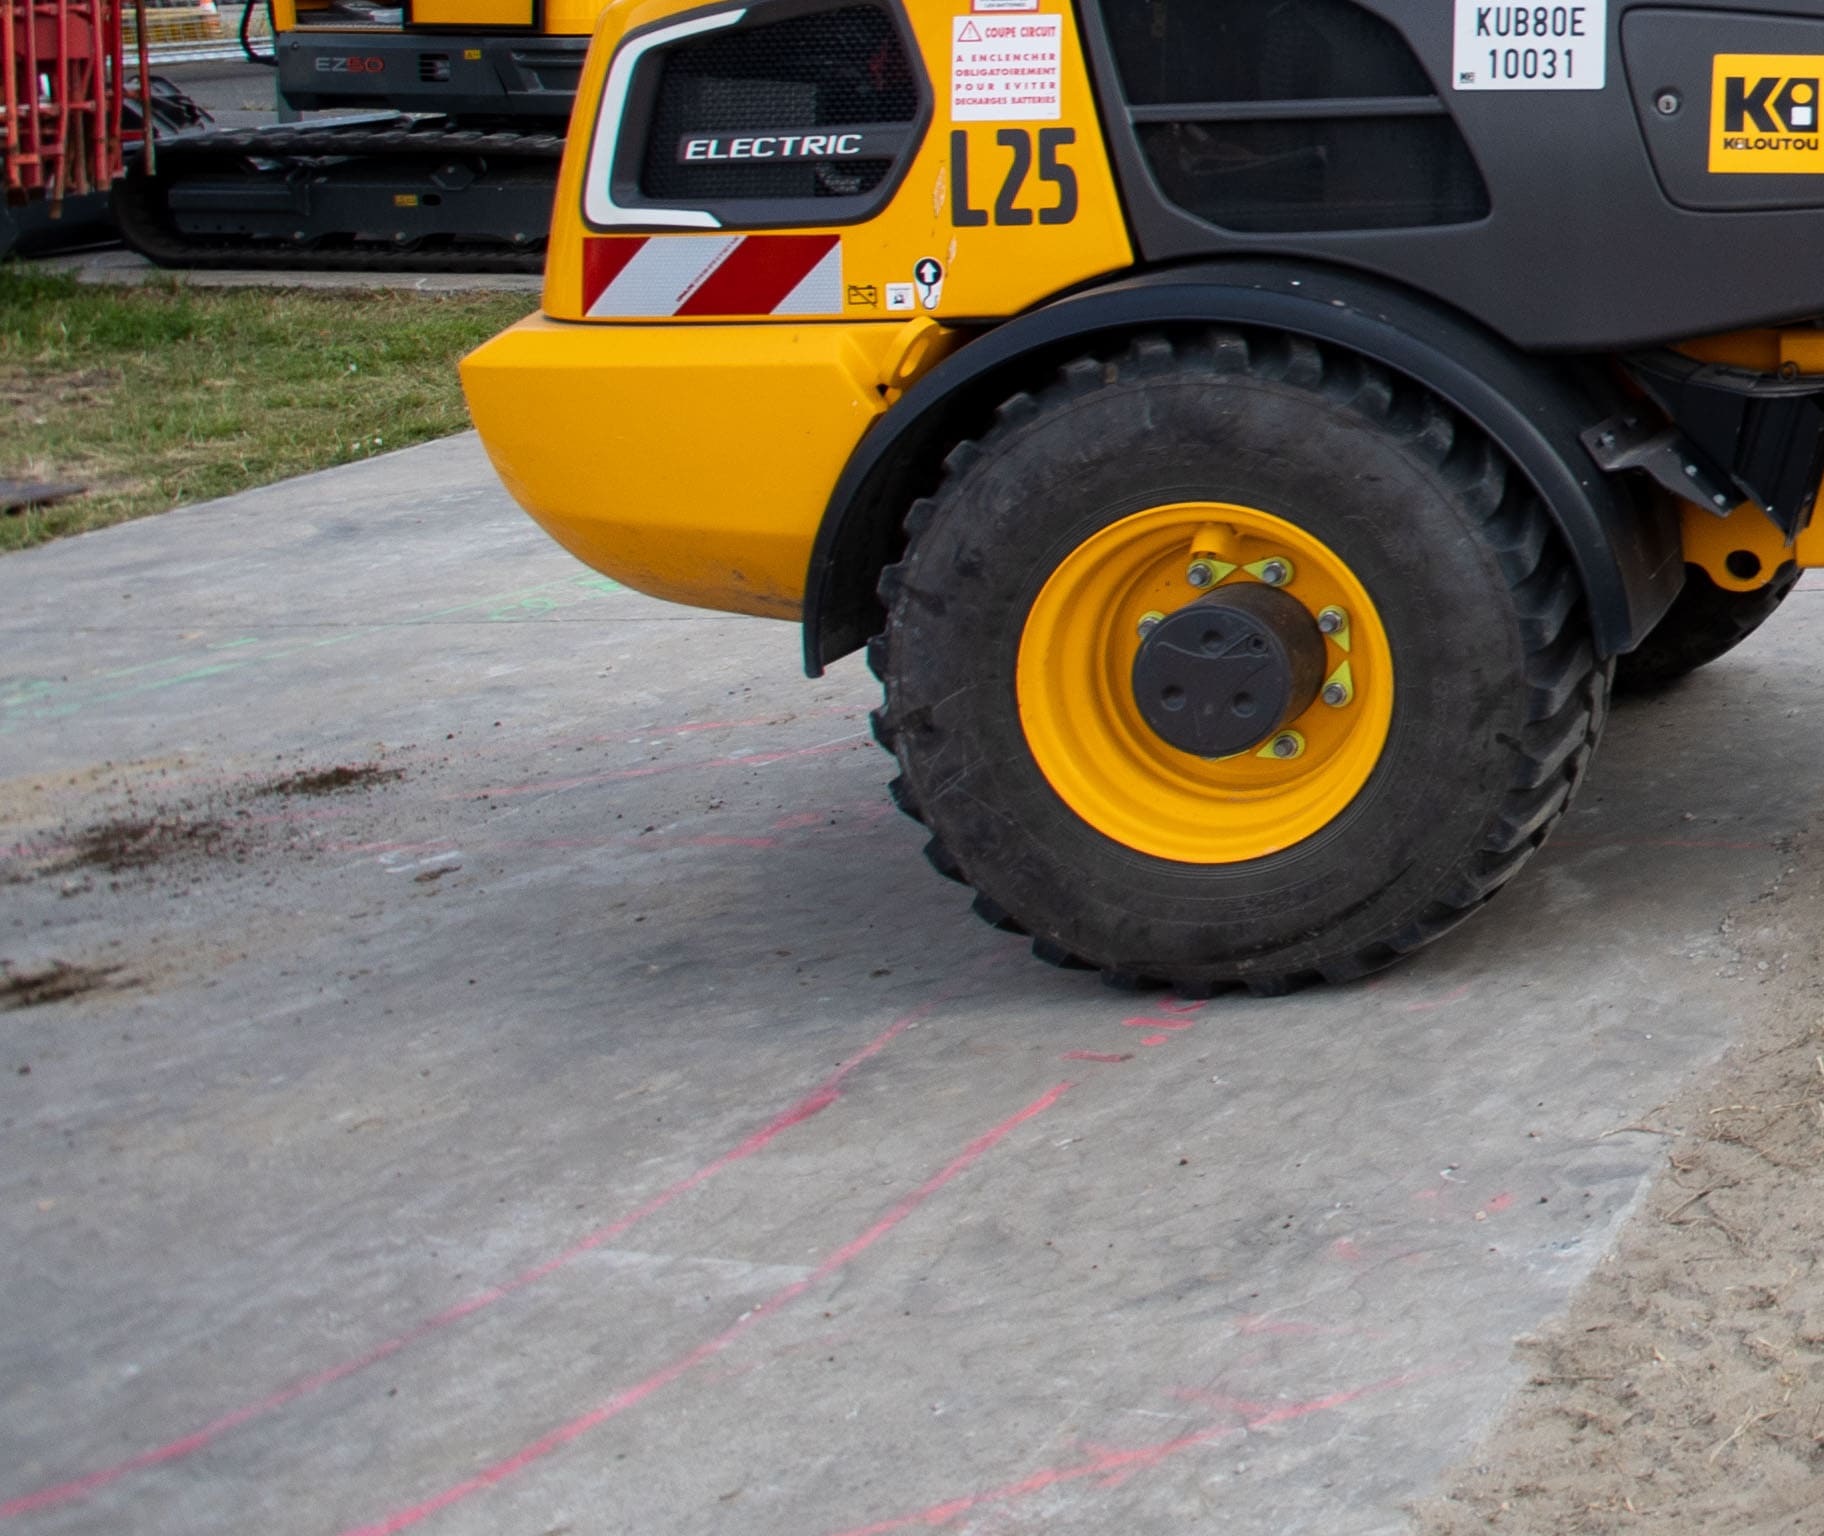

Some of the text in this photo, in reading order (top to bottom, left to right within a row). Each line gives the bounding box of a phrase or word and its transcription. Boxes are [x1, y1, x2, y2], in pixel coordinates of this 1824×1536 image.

[1477, 6, 1586, 36] KUB80E
[985, 26, 1056, 38] COUPE CIRCUIT
[955, 53, 1056, 63] A ENCLENCHER
[1489, 48, 1573, 79] 10031
[955, 67, 1056, 77] OBLIGATOIREMENT
[955, 81, 1056, 91] POUR EVITER
[955, 96, 1056, 106] DECHARGES BATTERIES
[684, 133, 863, 160] ELECTRIC
[950, 127, 1078, 227] L25
